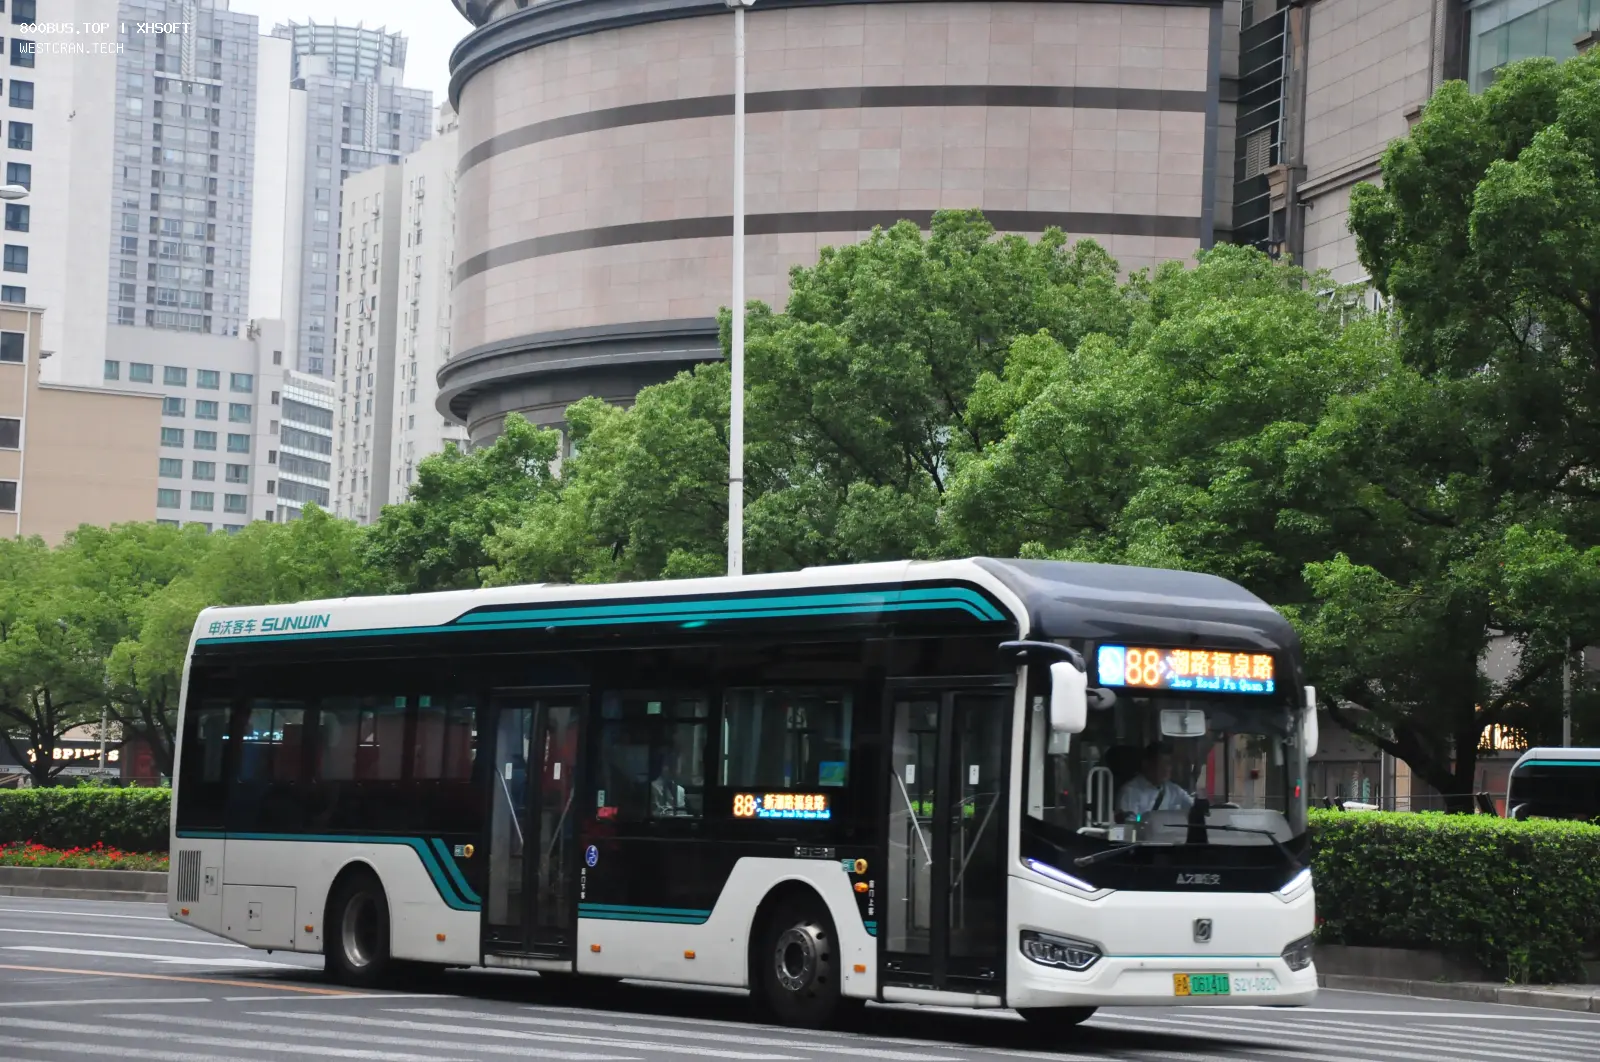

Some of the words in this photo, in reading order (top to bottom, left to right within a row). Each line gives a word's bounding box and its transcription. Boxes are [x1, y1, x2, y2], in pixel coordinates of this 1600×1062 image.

[208, 619, 257, 635] 申沃客车
[261, 613, 331, 632] SUNWIN
[1125, 649, 1160, 686] 88
[733, 793, 754, 817] 88
